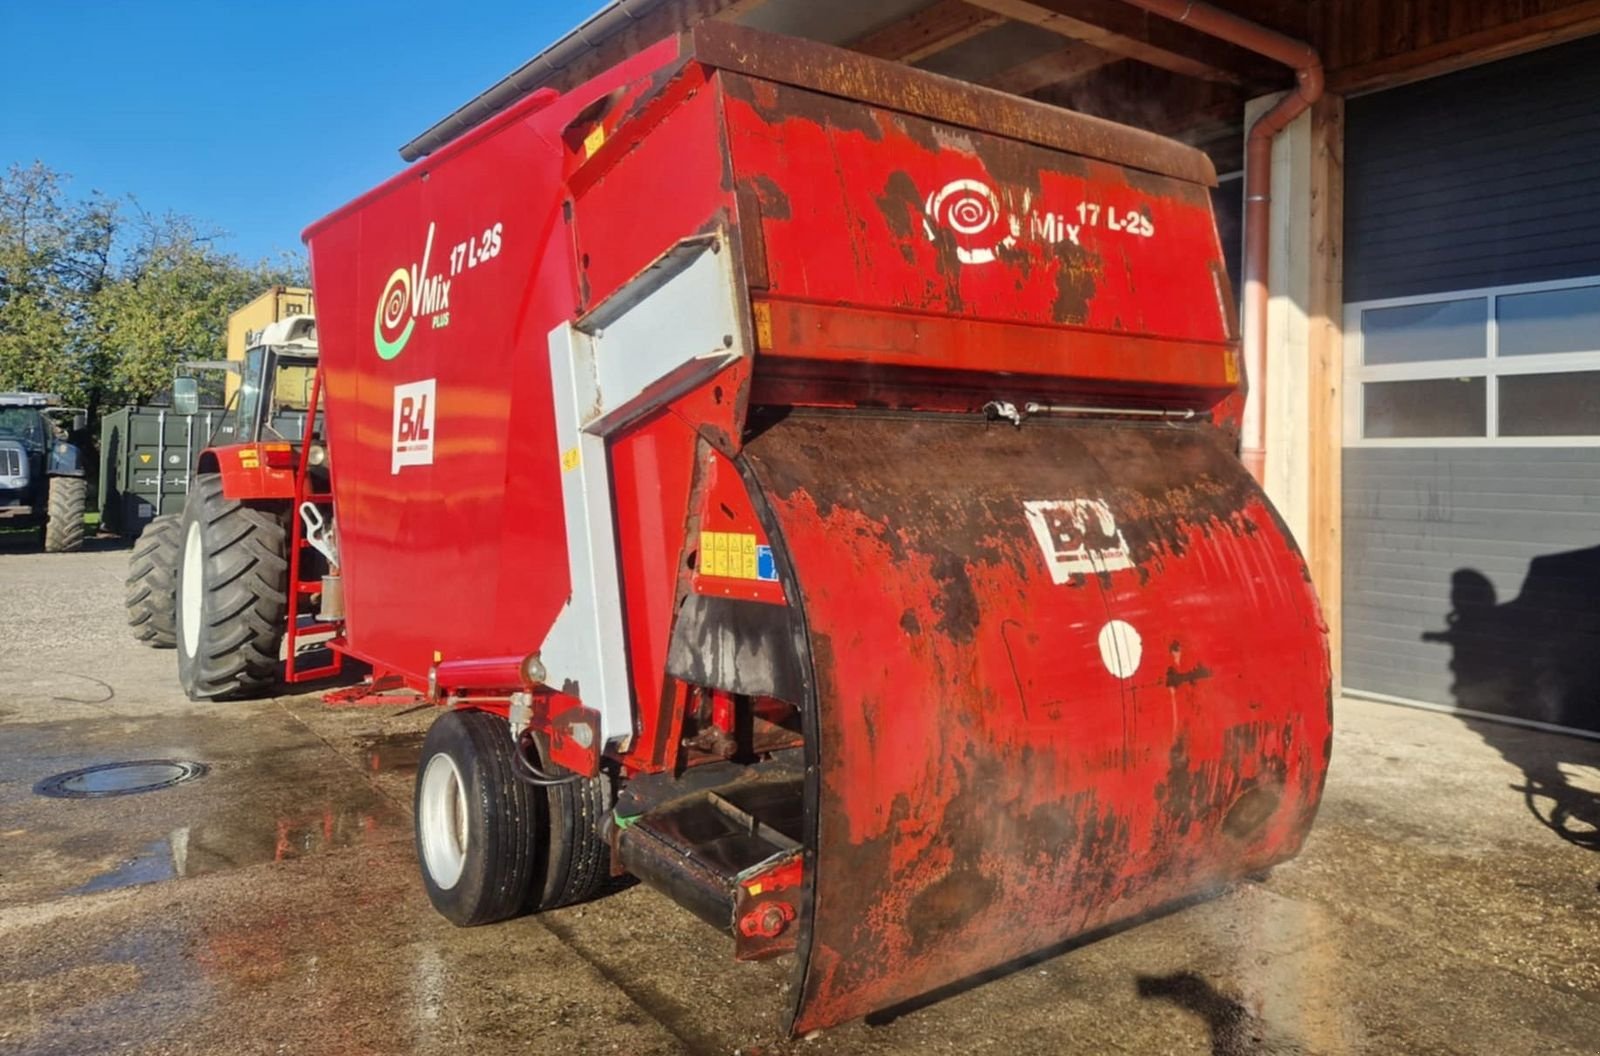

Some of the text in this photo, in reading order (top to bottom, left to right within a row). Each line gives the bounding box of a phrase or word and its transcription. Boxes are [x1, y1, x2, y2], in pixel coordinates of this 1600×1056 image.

[1076, 201, 1101, 226] 17
[410, 220, 452, 318] VMix
[449, 241, 468, 277] 17
[431, 311, 451, 330] PLUS
